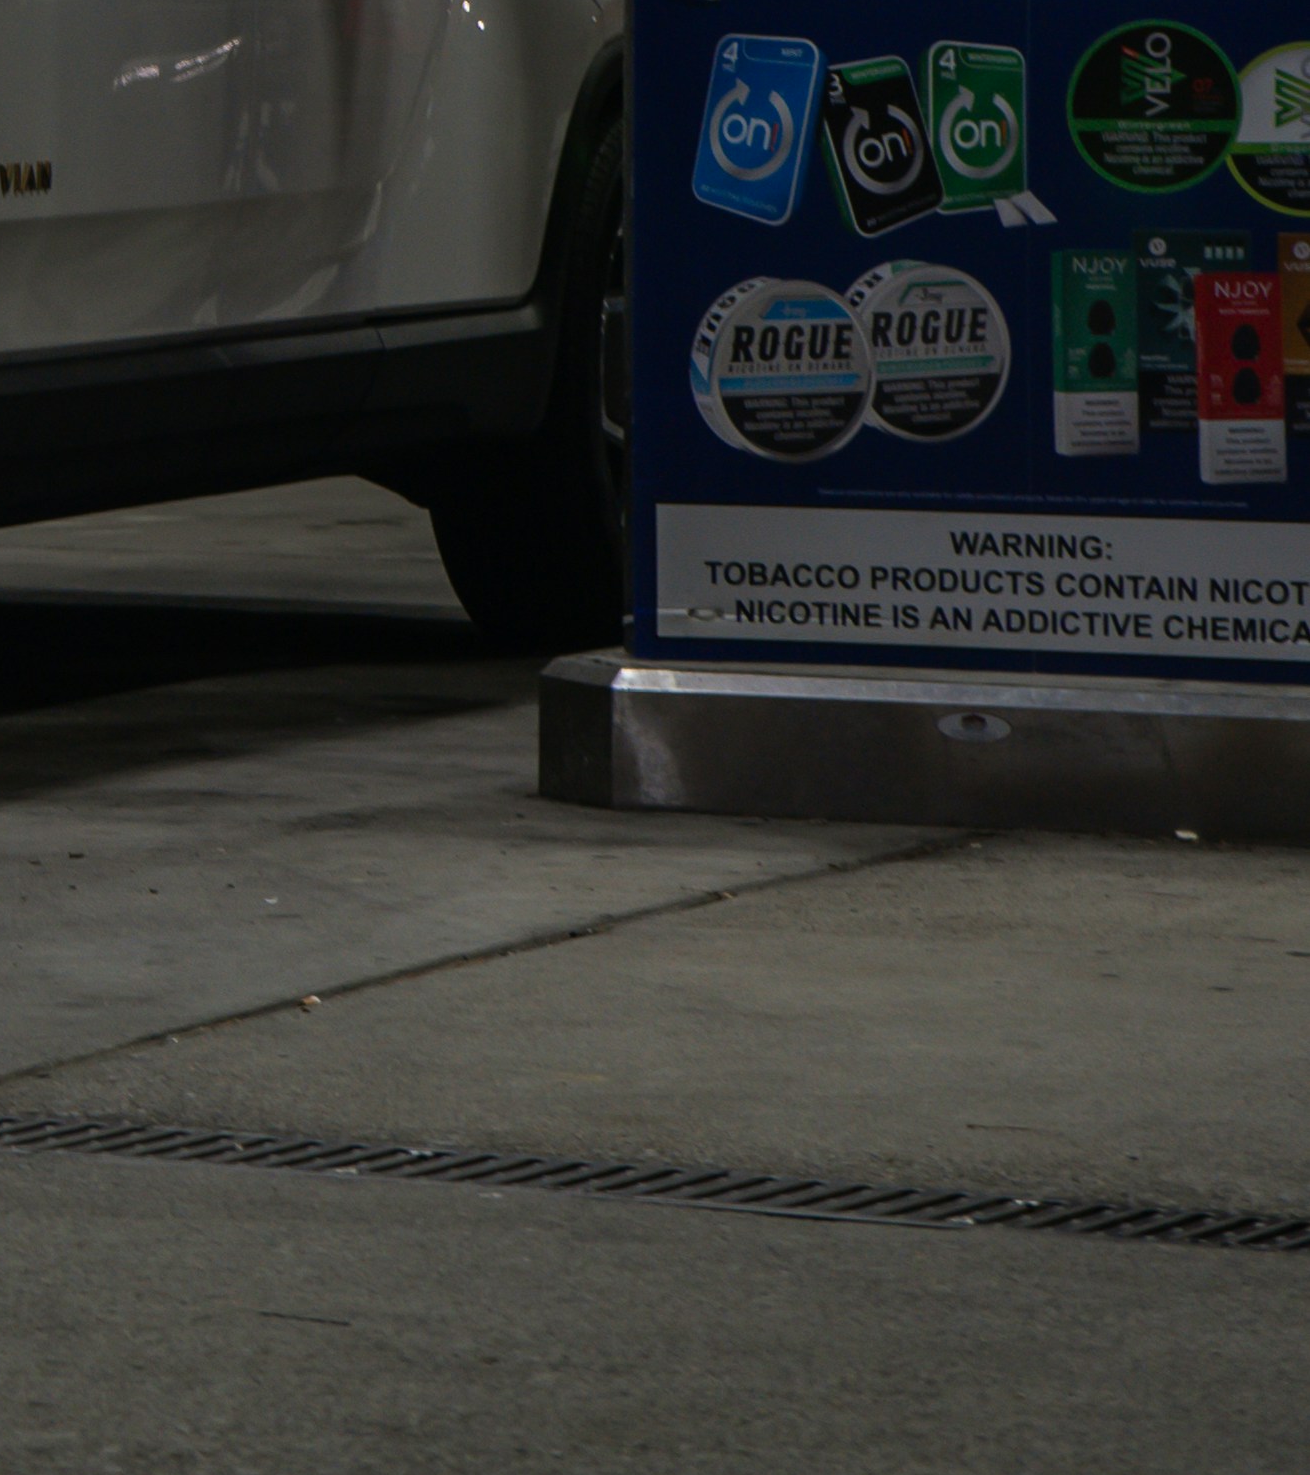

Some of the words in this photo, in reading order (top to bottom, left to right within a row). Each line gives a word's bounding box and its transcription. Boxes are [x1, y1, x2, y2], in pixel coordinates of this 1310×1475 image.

[721, 40, 740, 61] 4
[939, 48, 956, 72] 4
[1145, 31, 1172, 117] VELO
[1071, 256, 1128, 274] NJOY
[1214, 280, 1274, 300] NJOY
[731, 323, 854, 363] ROGUE
[872, 308, 989, 347] ROGUE
[950, 532, 1113, 561] WARNING:
[704, 560, 860, 588] TOBACCO
[870, 566, 1045, 596] PRODUCTS
[1056, 573, 1197, 602] CONTAIN
[1210, 578, 1310, 606] NICOT
[735, 599, 883, 628] NICOTINE
[893, 604, 920, 629] IS
[929, 605, 972, 632] AN
[982, 608, 1153, 639] ADDICTIVE
[1164, 615, 1310, 644] CHEMICA
